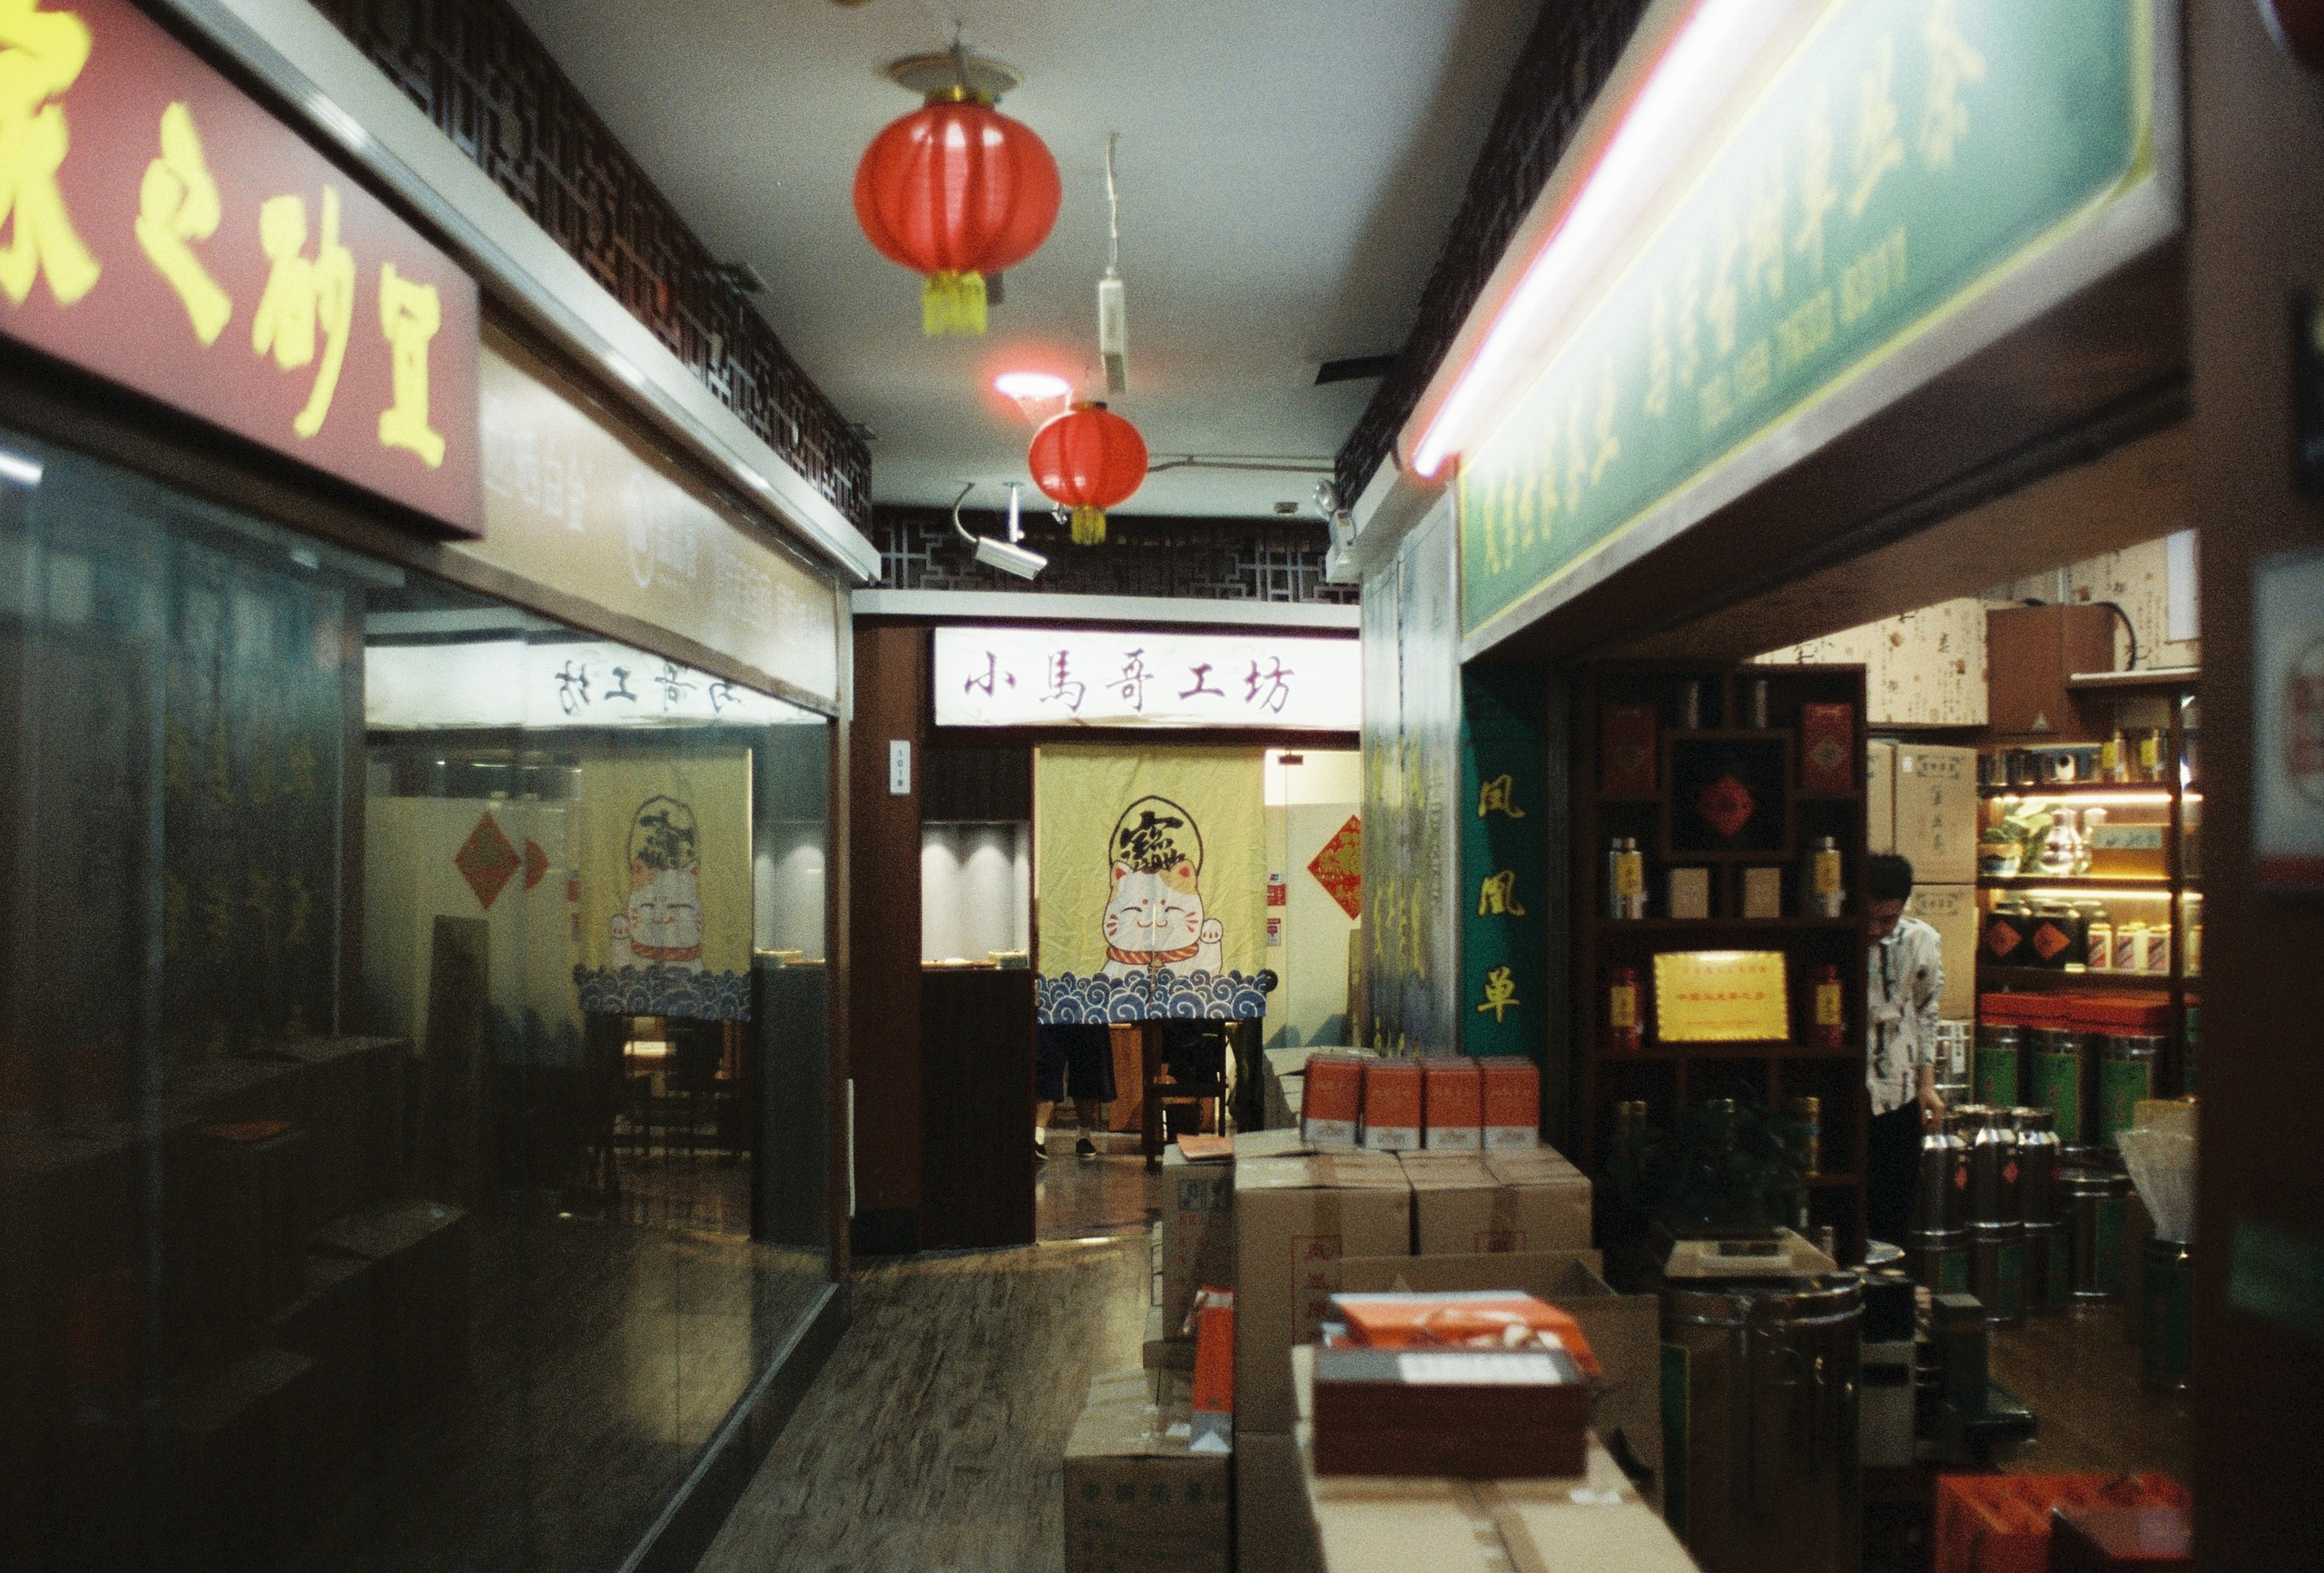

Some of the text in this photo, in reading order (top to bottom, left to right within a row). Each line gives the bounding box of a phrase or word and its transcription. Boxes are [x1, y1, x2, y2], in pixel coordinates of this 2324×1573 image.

[963, 647, 1296, 714] 小馬哥工坊
